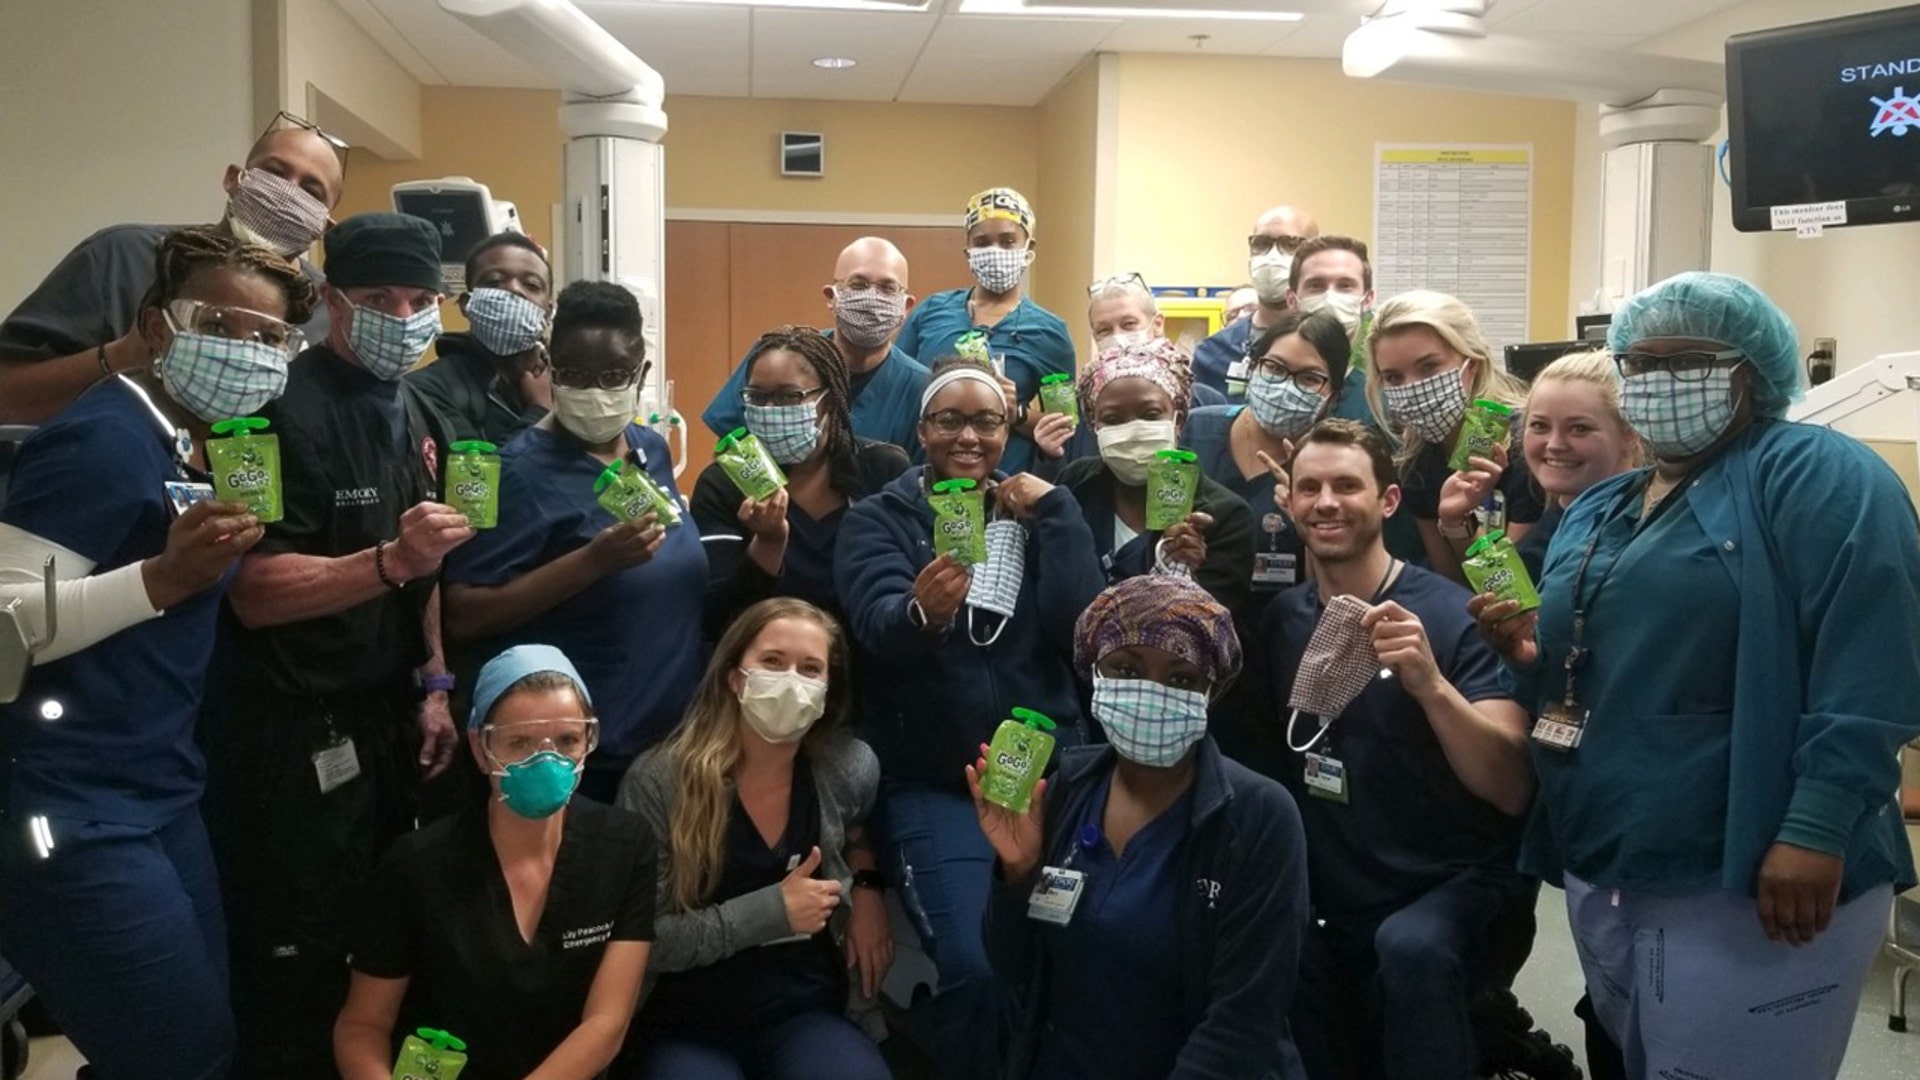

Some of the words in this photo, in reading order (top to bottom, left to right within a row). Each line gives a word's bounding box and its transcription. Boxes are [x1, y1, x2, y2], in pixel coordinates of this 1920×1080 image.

[1841, 58, 1920, 83] STAND
[1792, 206, 1823, 214] monitor
[1825, 203, 1844, 211] does
[1776, 217, 1795, 225] NOT
[1797, 215, 1830, 224] function
[227, 470, 265, 488] GoGo
[335, 487, 378, 499] EMORY
[456, 483, 485, 496] GoGo
[1157, 489, 1184, 500] GoGo
[942, 520, 971, 533] GoGo
[997, 753, 1028, 769] GoGo
[563, 934, 606, 948] Emergency
